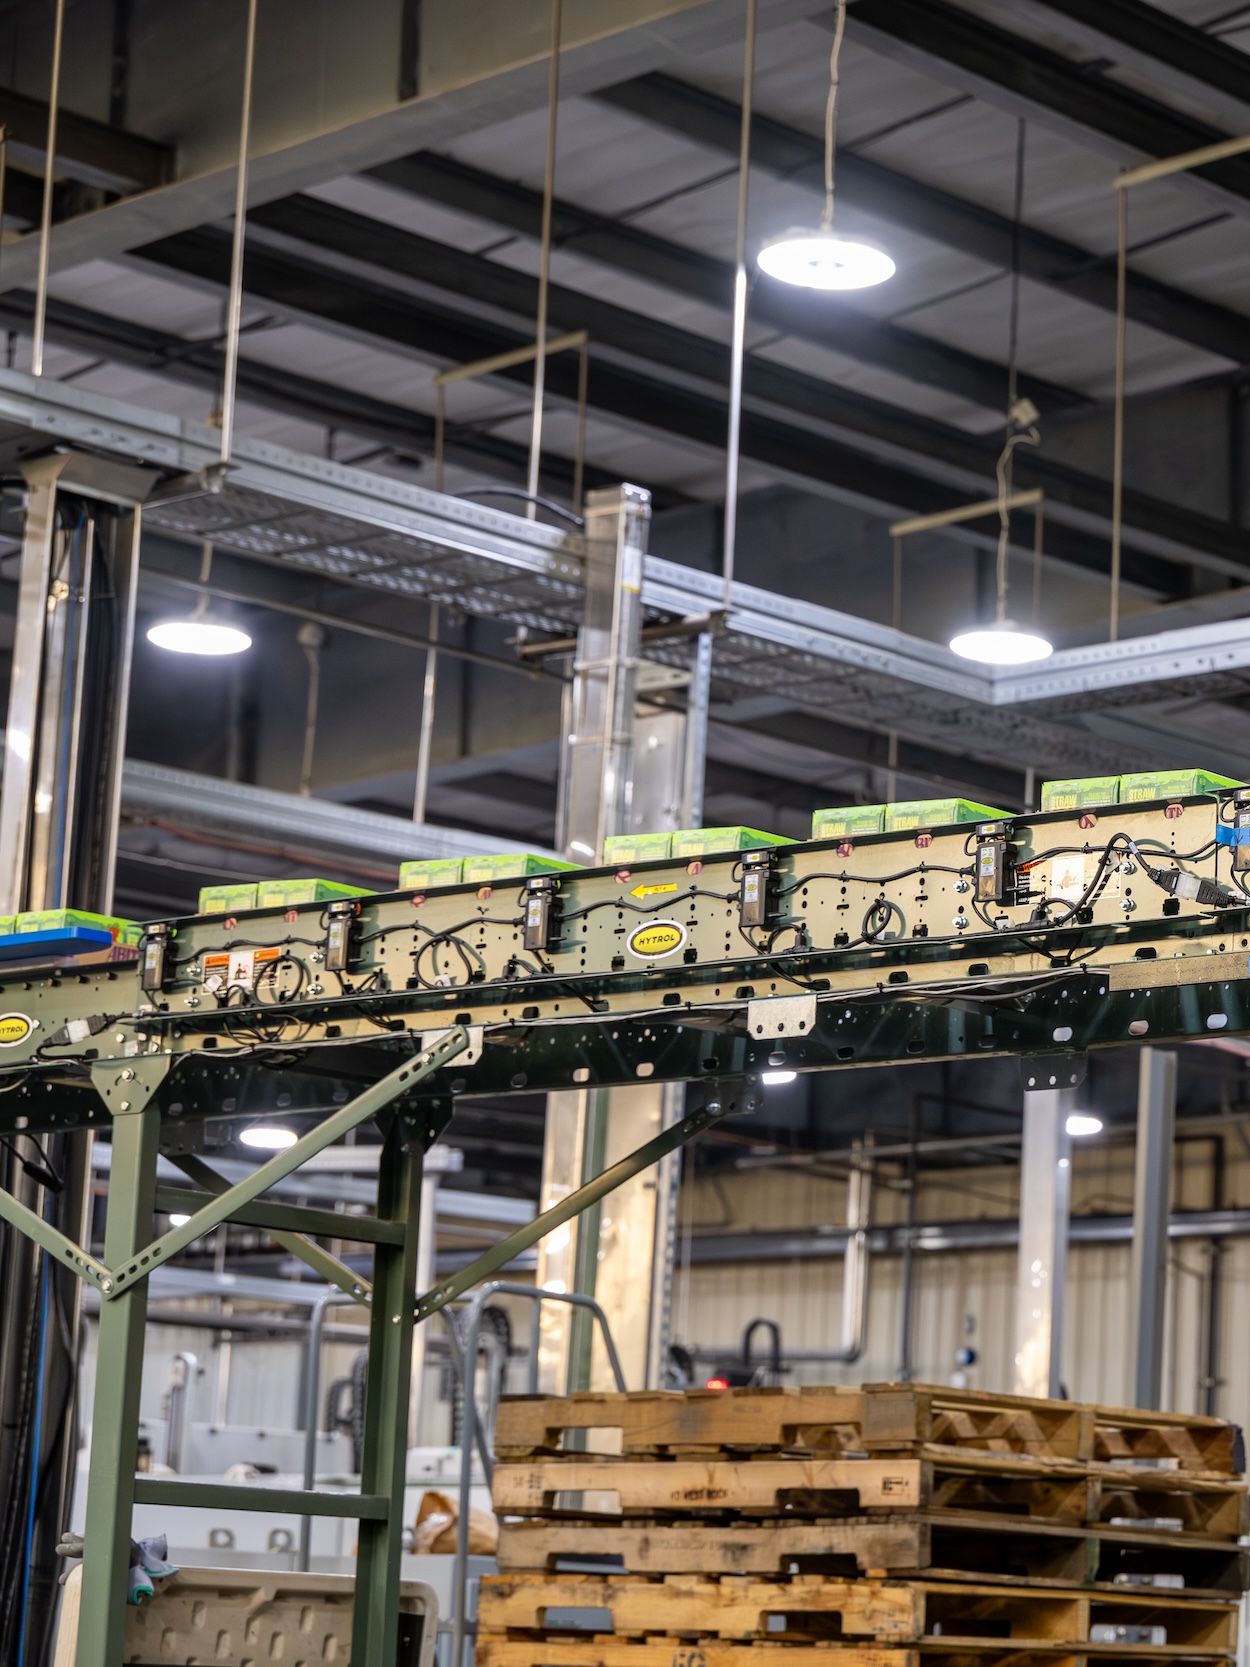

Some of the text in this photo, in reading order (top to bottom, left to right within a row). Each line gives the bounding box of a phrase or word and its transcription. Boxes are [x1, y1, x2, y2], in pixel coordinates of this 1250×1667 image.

[1129, 787, 1156, 800] STRAW
[1051, 794, 1078, 807] STRAW
[638, 934, 675, 945] HYTROL
[0, 1025, 24, 1034] YTROL
